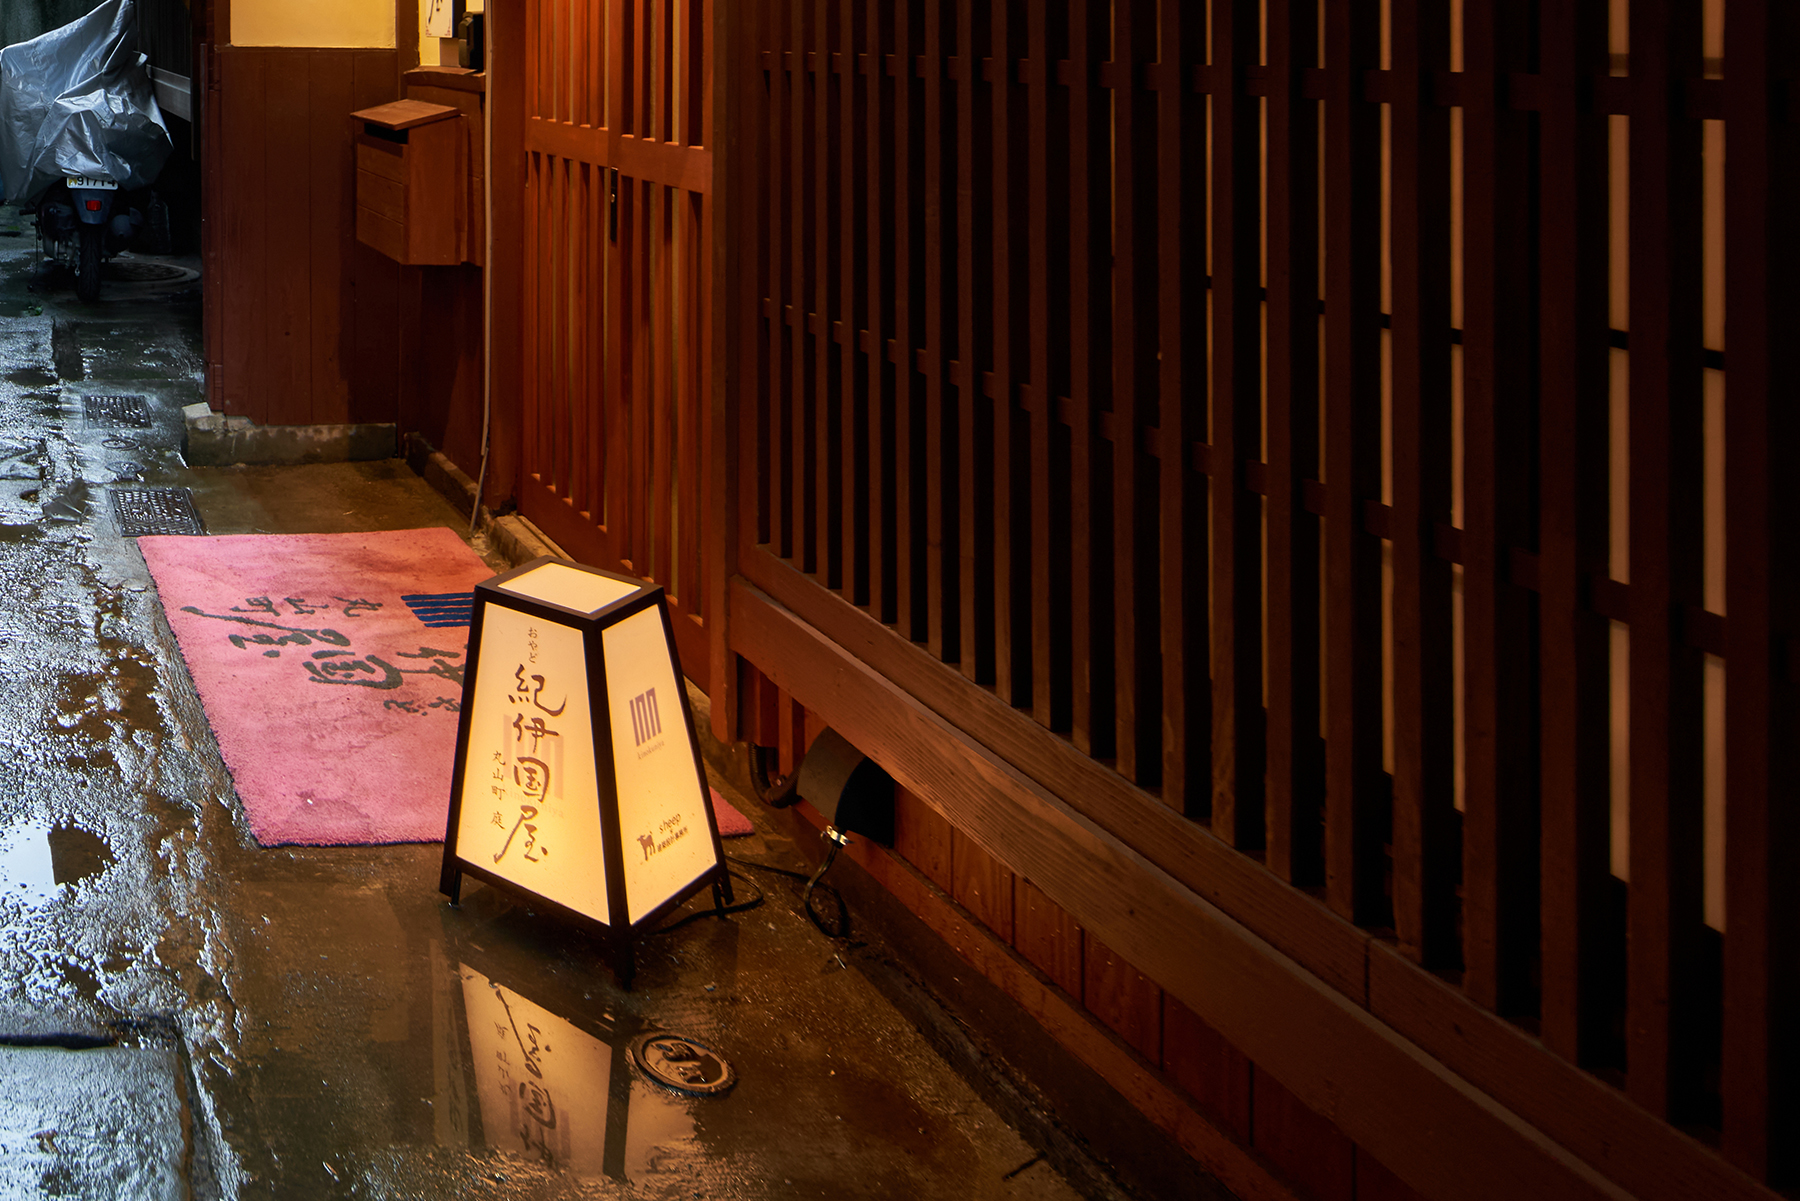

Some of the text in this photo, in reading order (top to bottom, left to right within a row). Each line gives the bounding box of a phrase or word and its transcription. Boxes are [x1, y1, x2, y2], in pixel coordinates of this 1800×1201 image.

[181, 606, 468, 690] 伊国屋
[528, 627, 538, 664] おやど
[492, 751, 506, 800] 丸山町
[493, 664, 567, 864] 紀伊国屋
[659, 813, 681, 834] sheep
